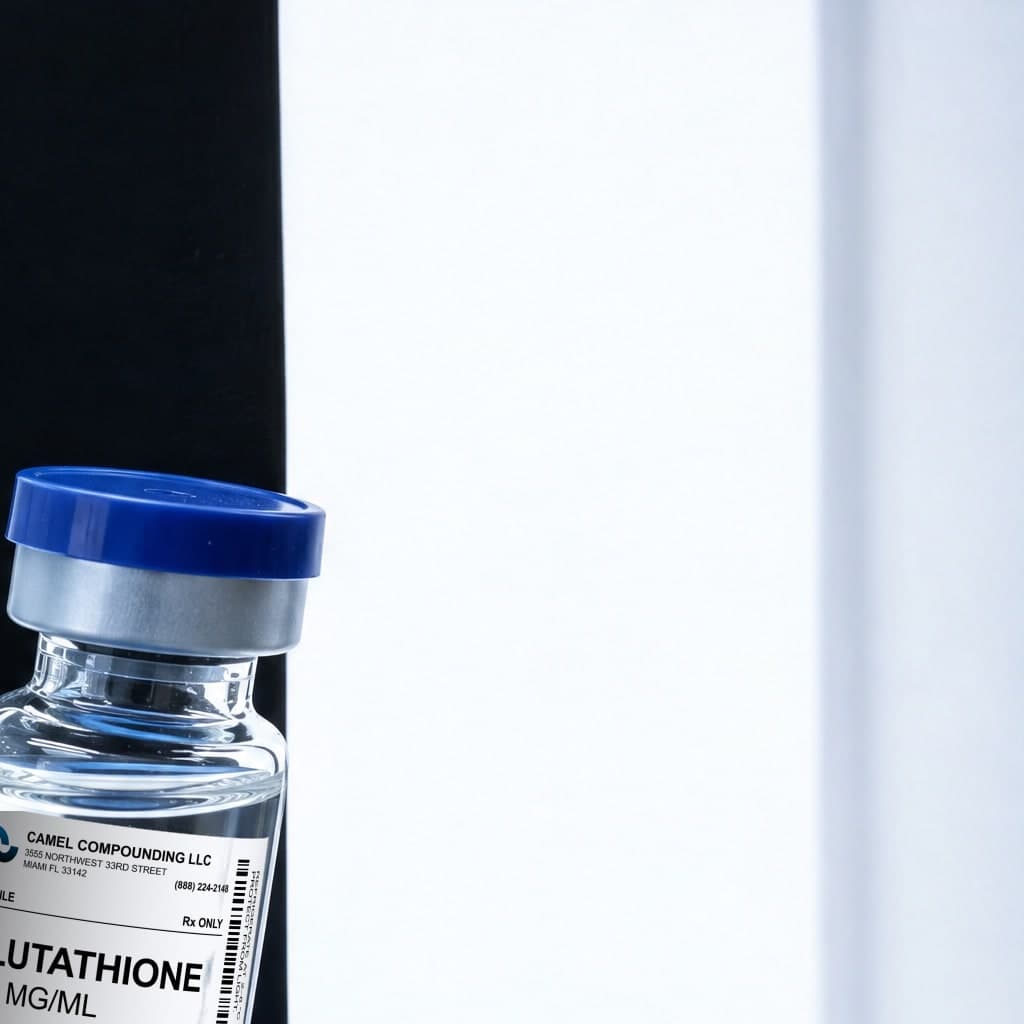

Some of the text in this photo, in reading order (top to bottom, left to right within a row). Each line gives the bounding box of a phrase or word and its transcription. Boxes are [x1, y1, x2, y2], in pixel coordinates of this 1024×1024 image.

[24, 848, 168, 876] 3555 NORTHWEST 33RD STREET
[27, 831, 212, 866] CAMEL COMPOUNDING LLC
[23, 859, 88, 878] MIAMI FL 33142
[174, 880, 229, 893] (888) 224-2148
[244, 871, 256, 928] PROTECT
[182, 916, 223, 929] Rx ONLY
[237, 934, 248, 971] FROM
[6, 982, 97, 1018] MG/ML
